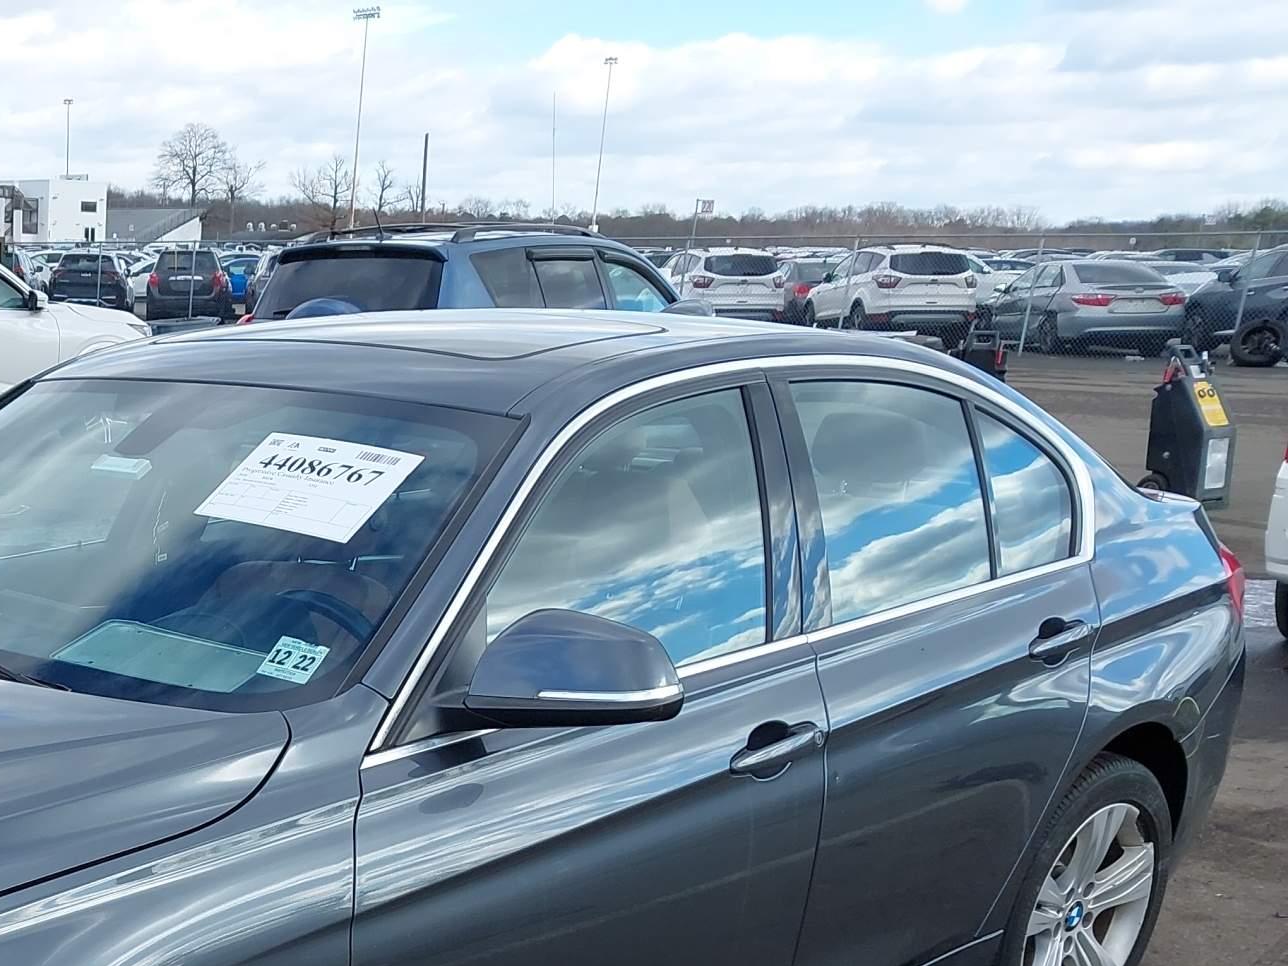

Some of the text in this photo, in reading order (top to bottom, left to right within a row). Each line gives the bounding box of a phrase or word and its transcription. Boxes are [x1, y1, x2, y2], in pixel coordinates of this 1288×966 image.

[259, 454, 385, 487] 44086767
[268, 648, 293, 666] 12
[291, 653, 316, 672] 22
